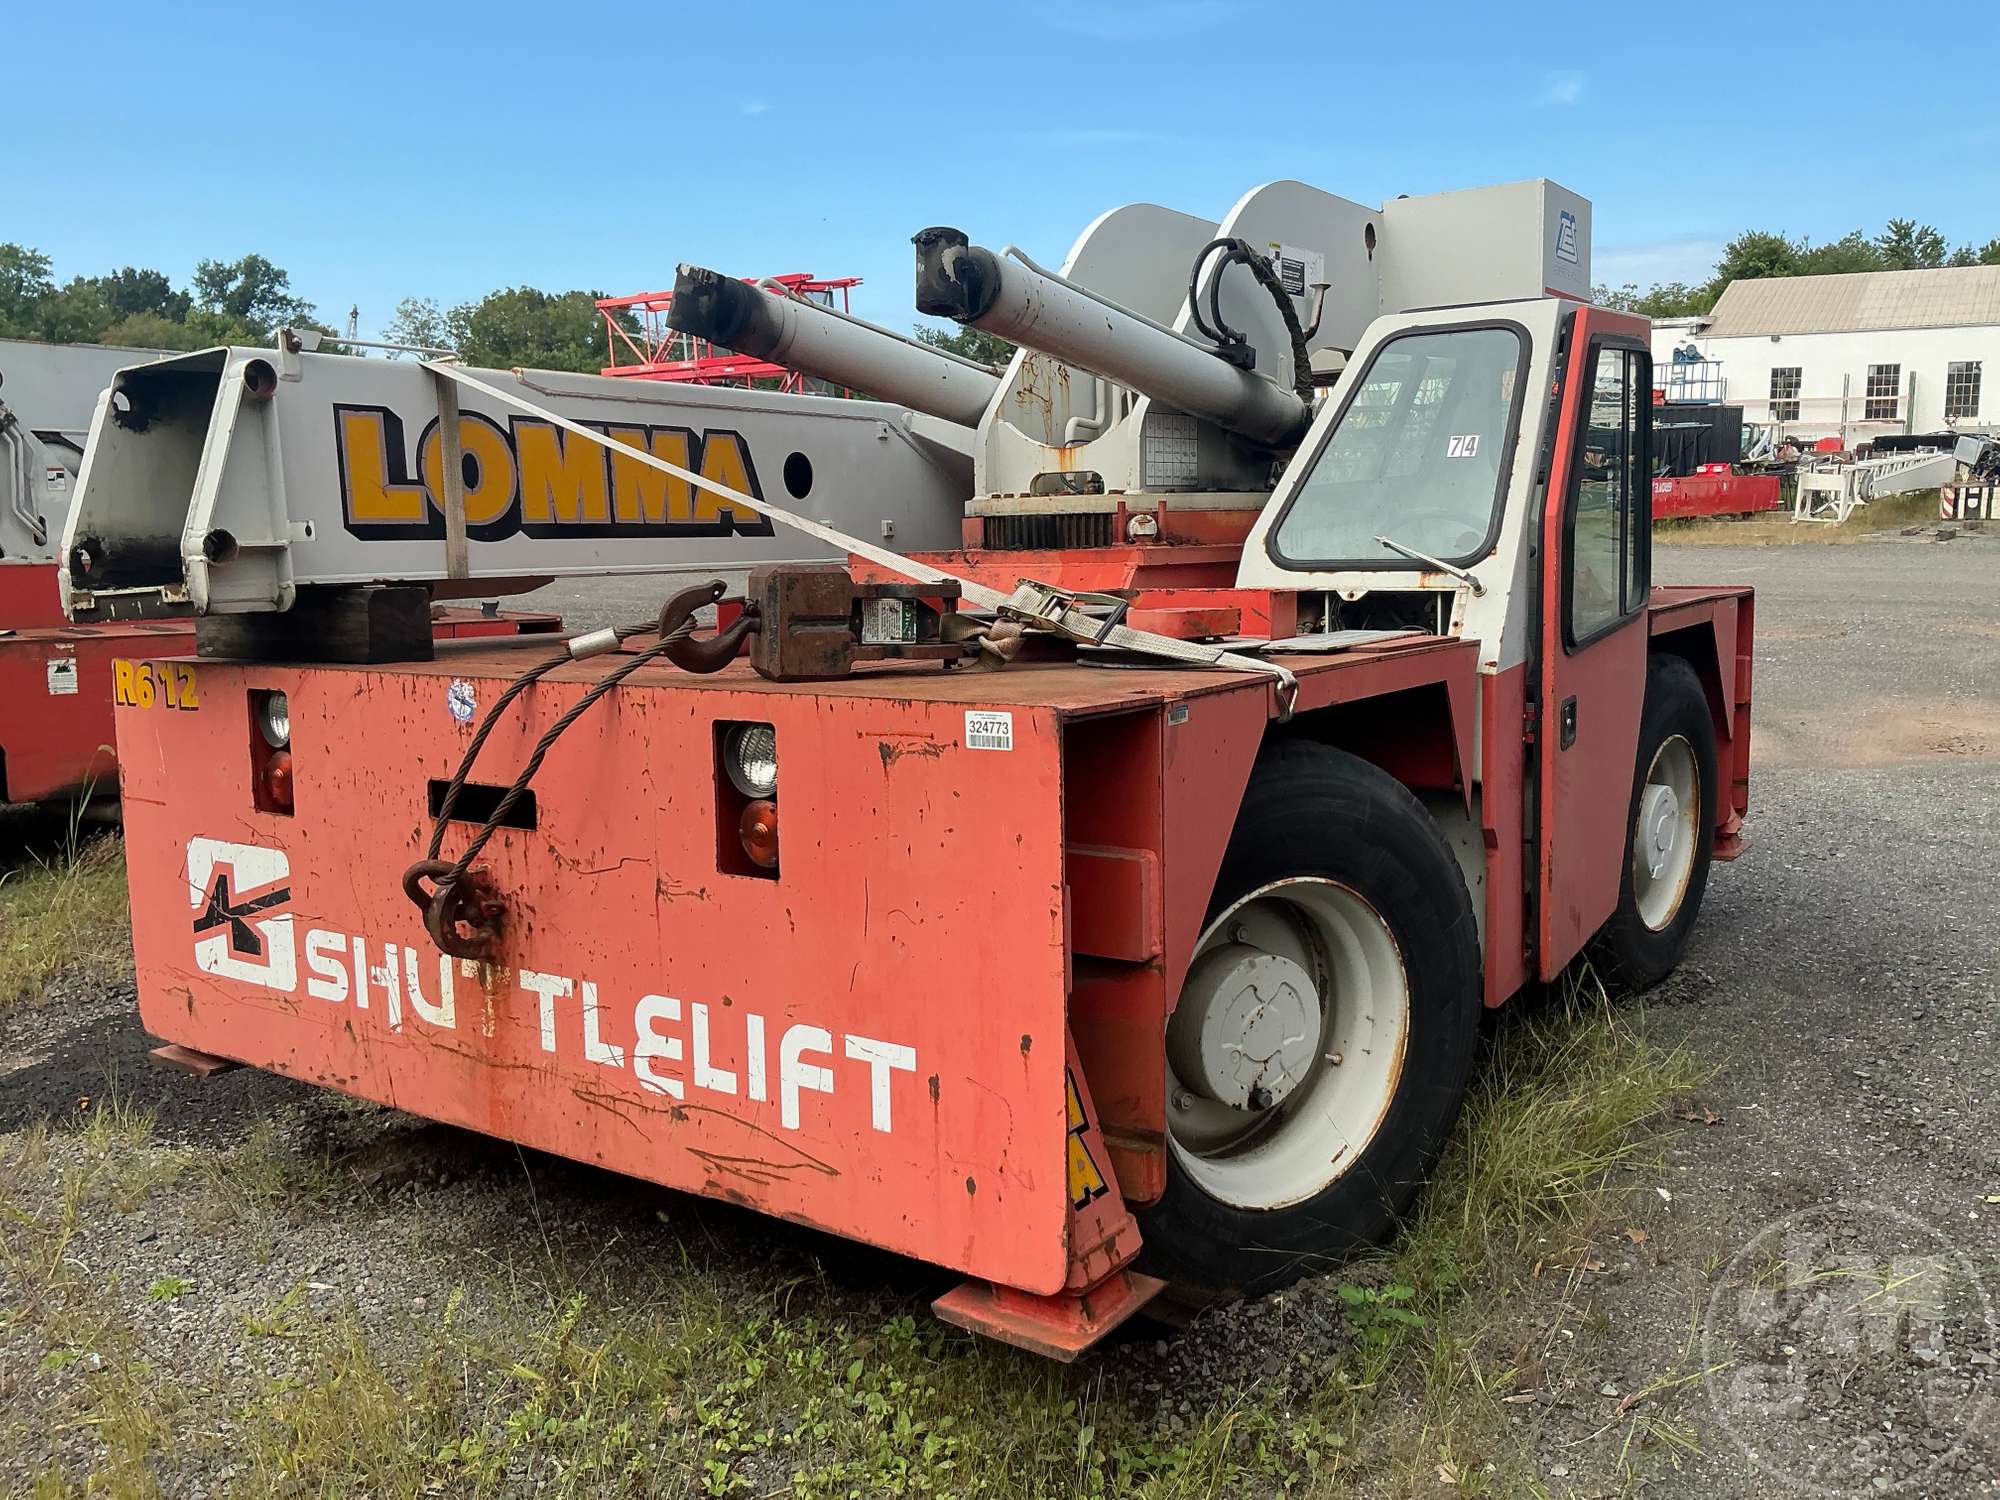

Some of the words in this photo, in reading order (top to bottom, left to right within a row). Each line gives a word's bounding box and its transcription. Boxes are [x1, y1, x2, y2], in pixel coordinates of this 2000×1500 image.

[1450, 436, 1477, 456] 74
[333, 403, 776, 542] LOMMA
[114, 660, 199, 711] R612
[969, 720, 1009, 735] 324773
